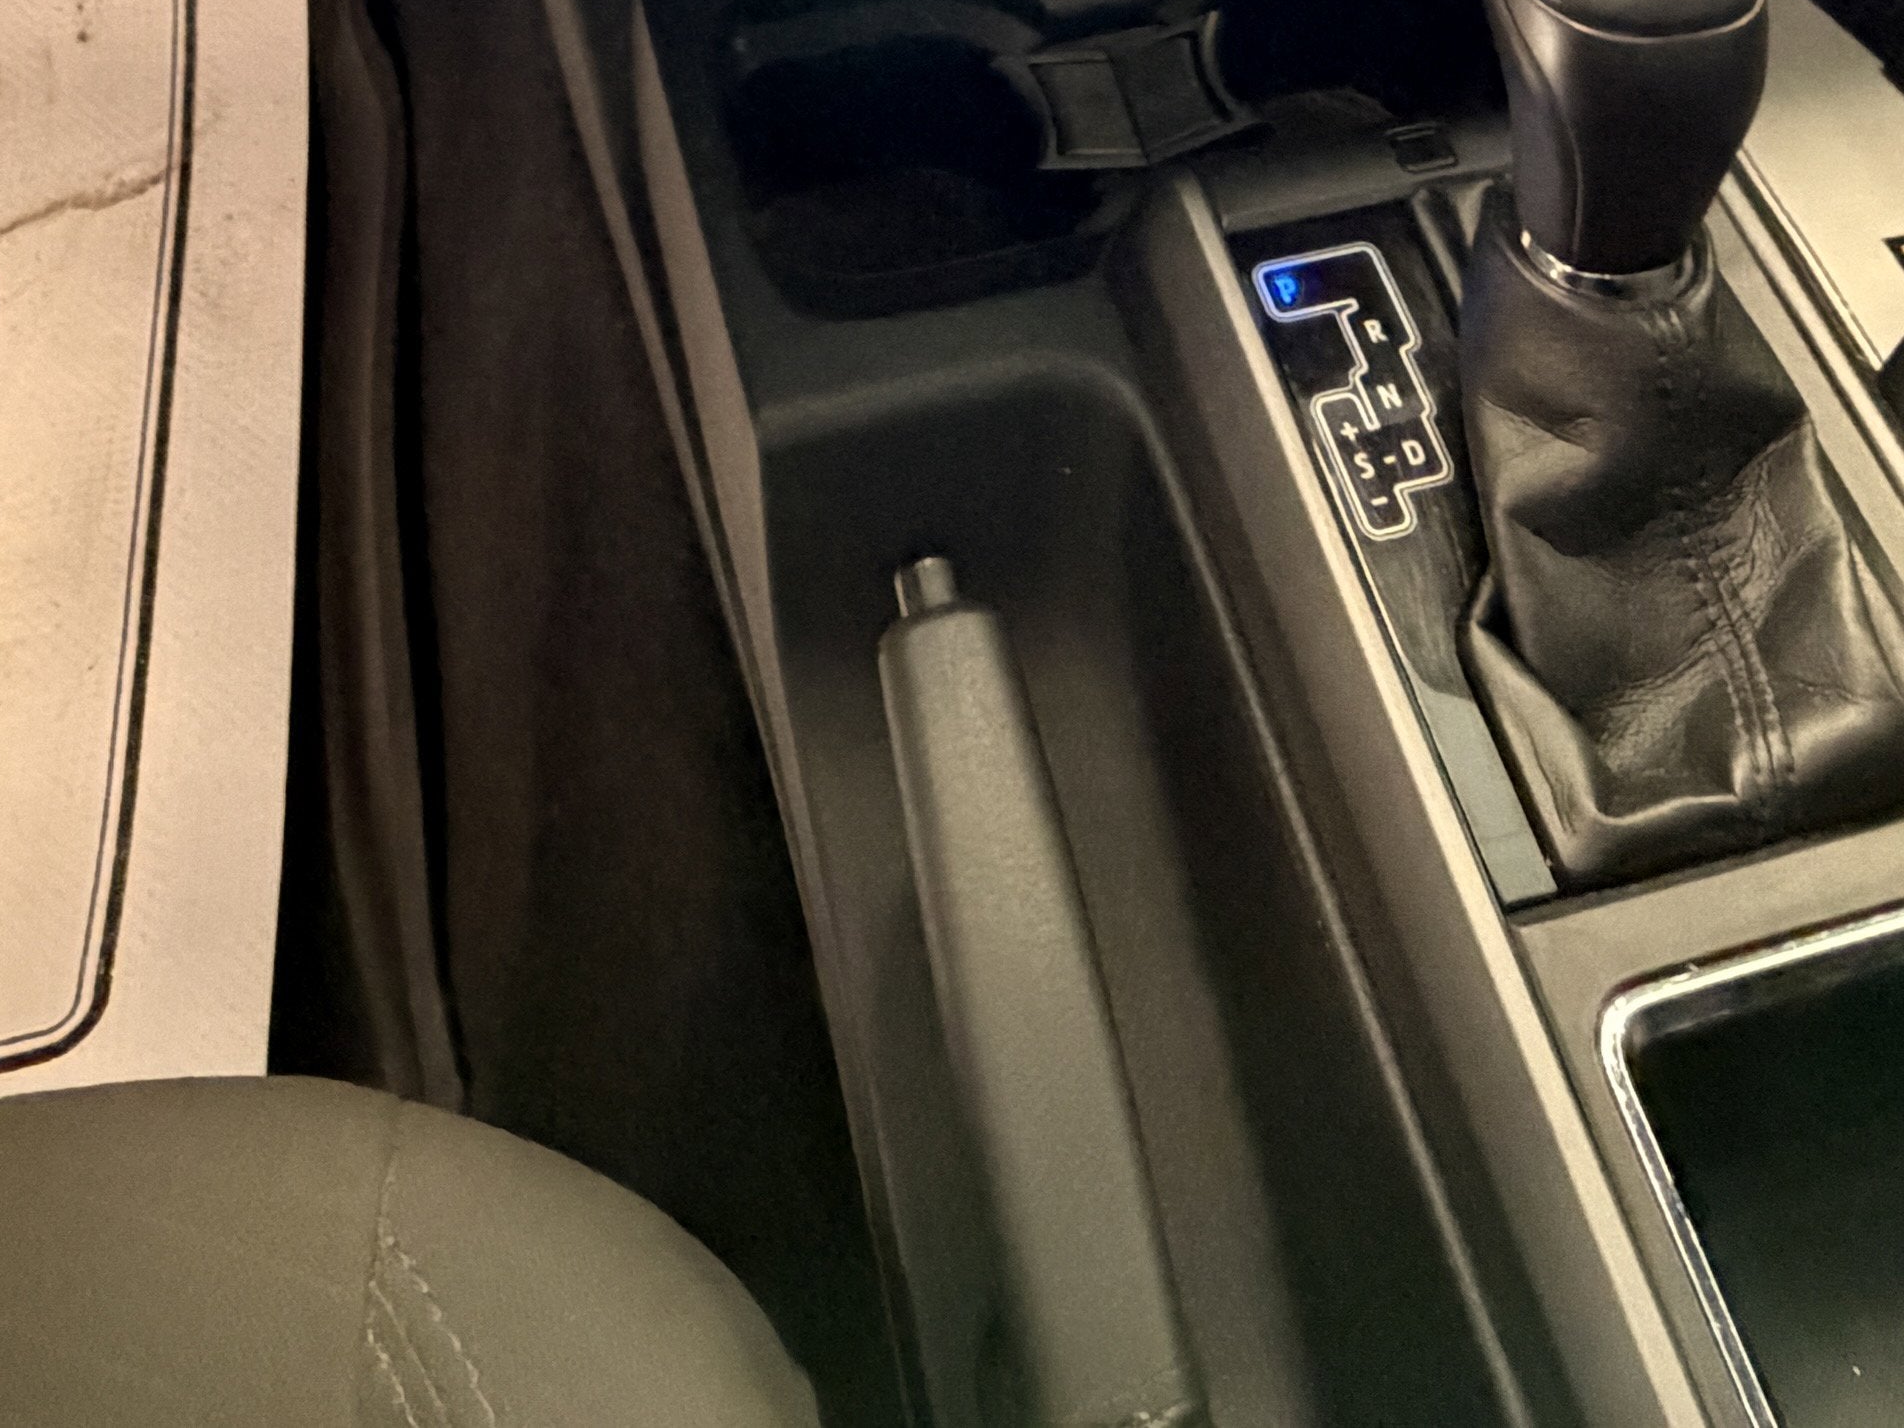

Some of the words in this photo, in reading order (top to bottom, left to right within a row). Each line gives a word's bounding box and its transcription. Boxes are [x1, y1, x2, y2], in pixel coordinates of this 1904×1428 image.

[1274, 275, 1297, 305] P
[1363, 318, 1389, 343] R
[1376, 382, 1403, 410] N
[1353, 451, 1376, 480] S
[1401, 438, 1426, 466] D
